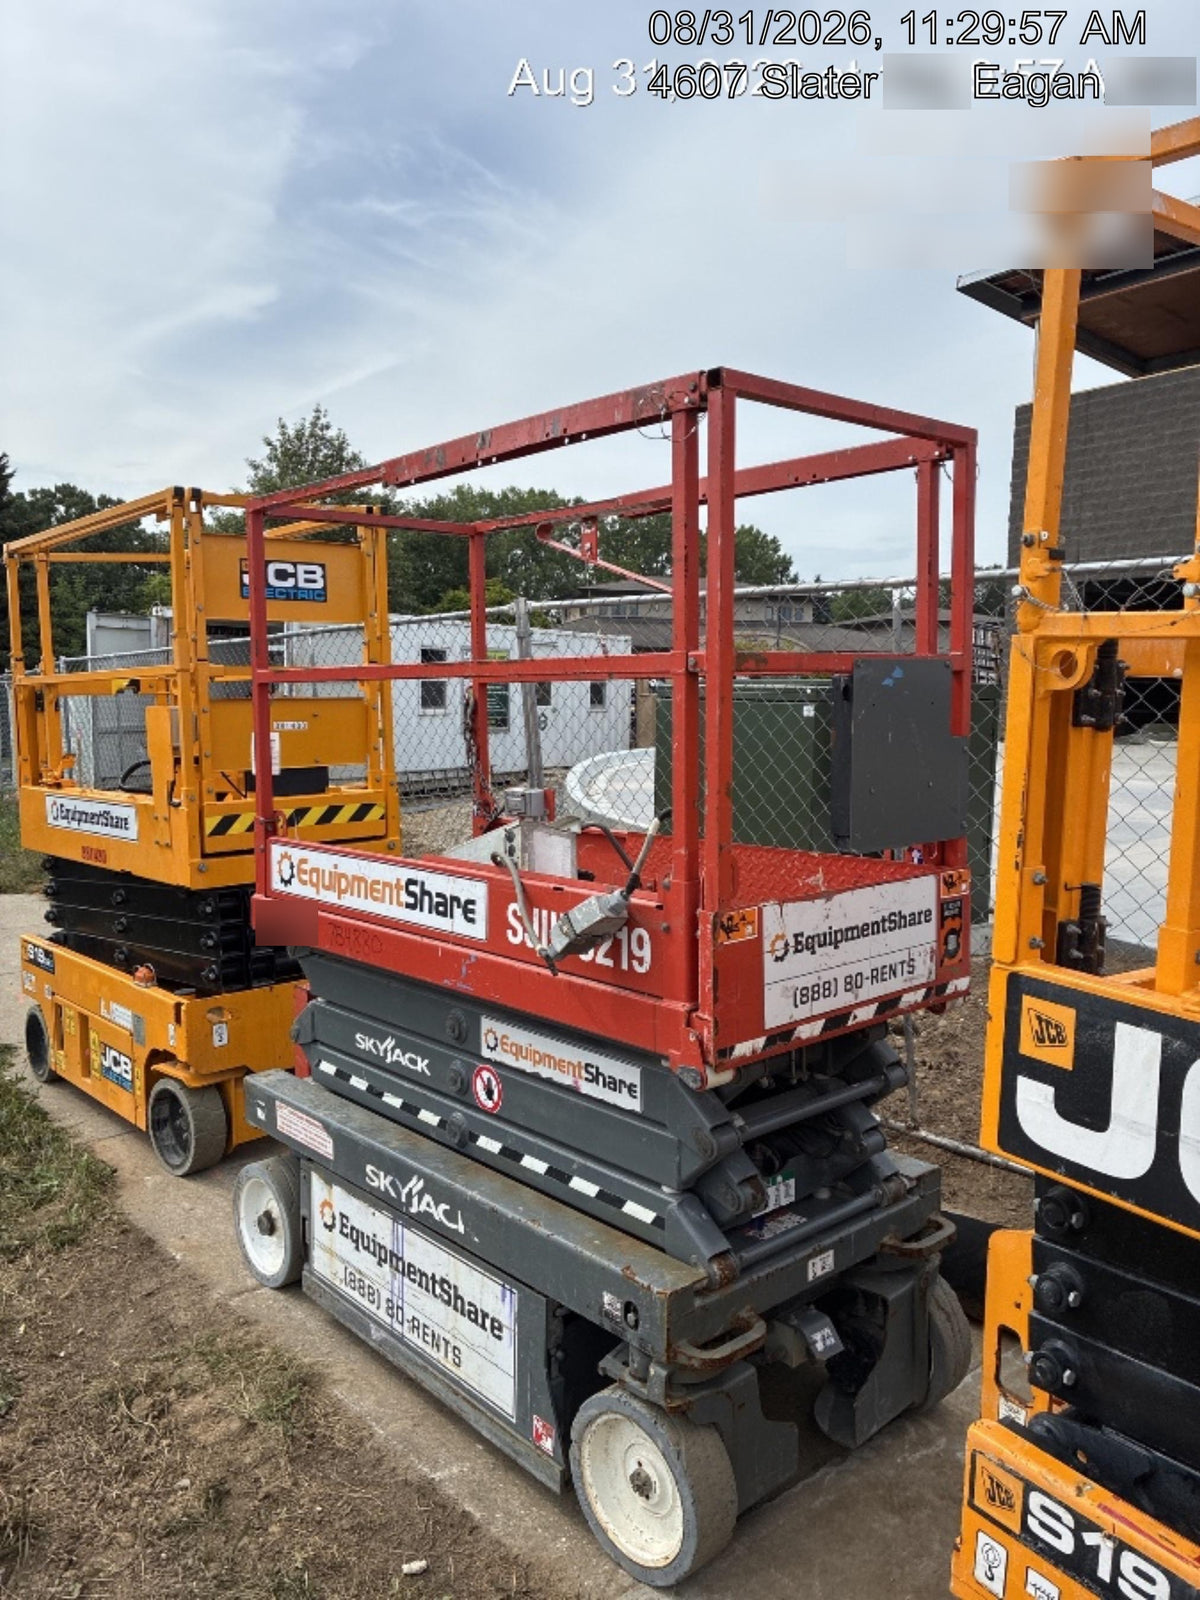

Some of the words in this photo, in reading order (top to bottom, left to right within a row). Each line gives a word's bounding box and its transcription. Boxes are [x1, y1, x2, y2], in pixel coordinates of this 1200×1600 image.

[242, 562, 325, 590] CB
[242, 586, 326, 601] EECTRIC
[59, 802, 130, 831] EquipmentShare
[297, 857, 477, 924] EquipmentShare
[793, 907, 933, 954] EquipmentShare
[793, 977, 839, 1009] (888)
[843, 957, 916, 991] 80-RENTS
[1034, 1014, 1067, 1046] JCB
[102, 1046, 132, 1081] JCB
[354, 1032, 431, 1076] SKYJACK
[500, 1033, 639, 1100] EquipmentShare
[339, 1211, 504, 1342] EquipmentShare
[343, 1266, 381, 1311] (888)
[385, 1297, 462, 1368] 80-RENTS
[986, 1473, 1015, 1509] JCB
[1027, 1490, 1171, 1600] S19
